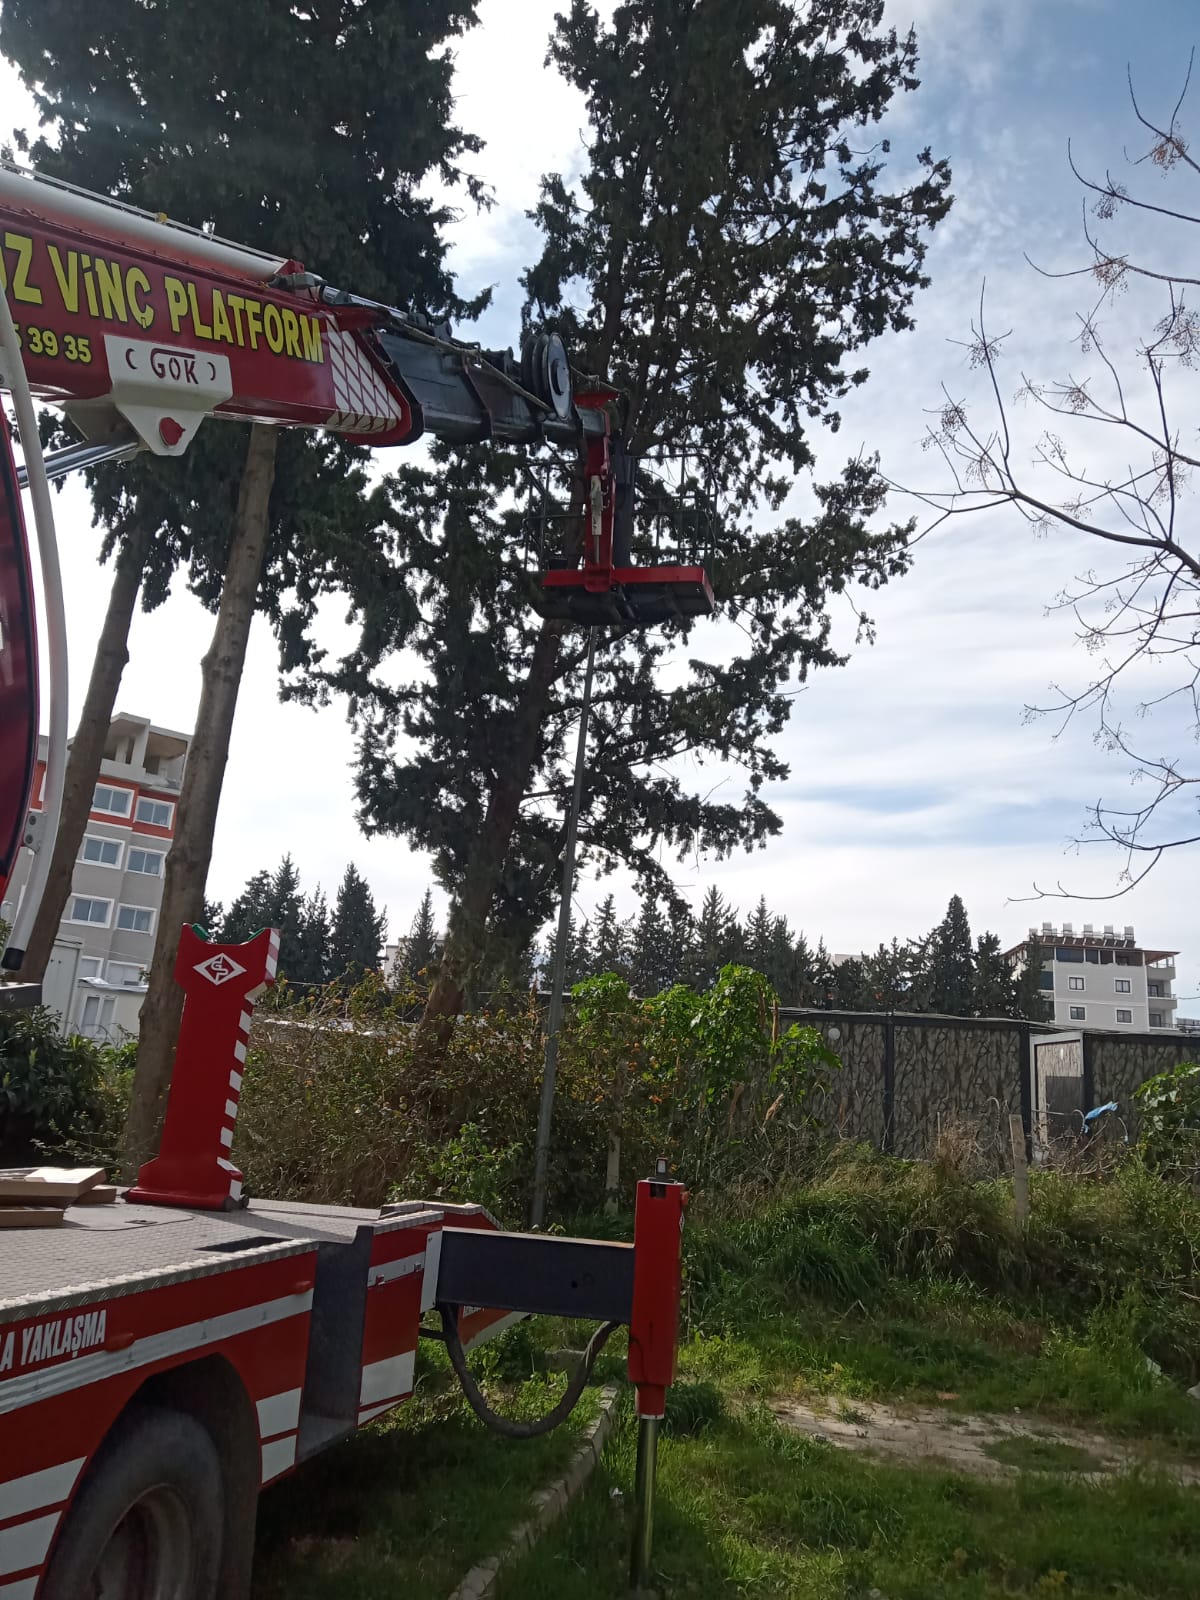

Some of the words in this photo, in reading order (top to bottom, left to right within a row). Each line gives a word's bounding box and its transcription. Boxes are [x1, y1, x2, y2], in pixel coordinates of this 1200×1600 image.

[27, 327, 59, 357] 39
[63, 335, 92, 363] 35
[164, 276, 324, 364] PLATFORM
[0, 1331, 15, 1372] A
[20, 1310, 107, 1366] YAKLAŞMA
